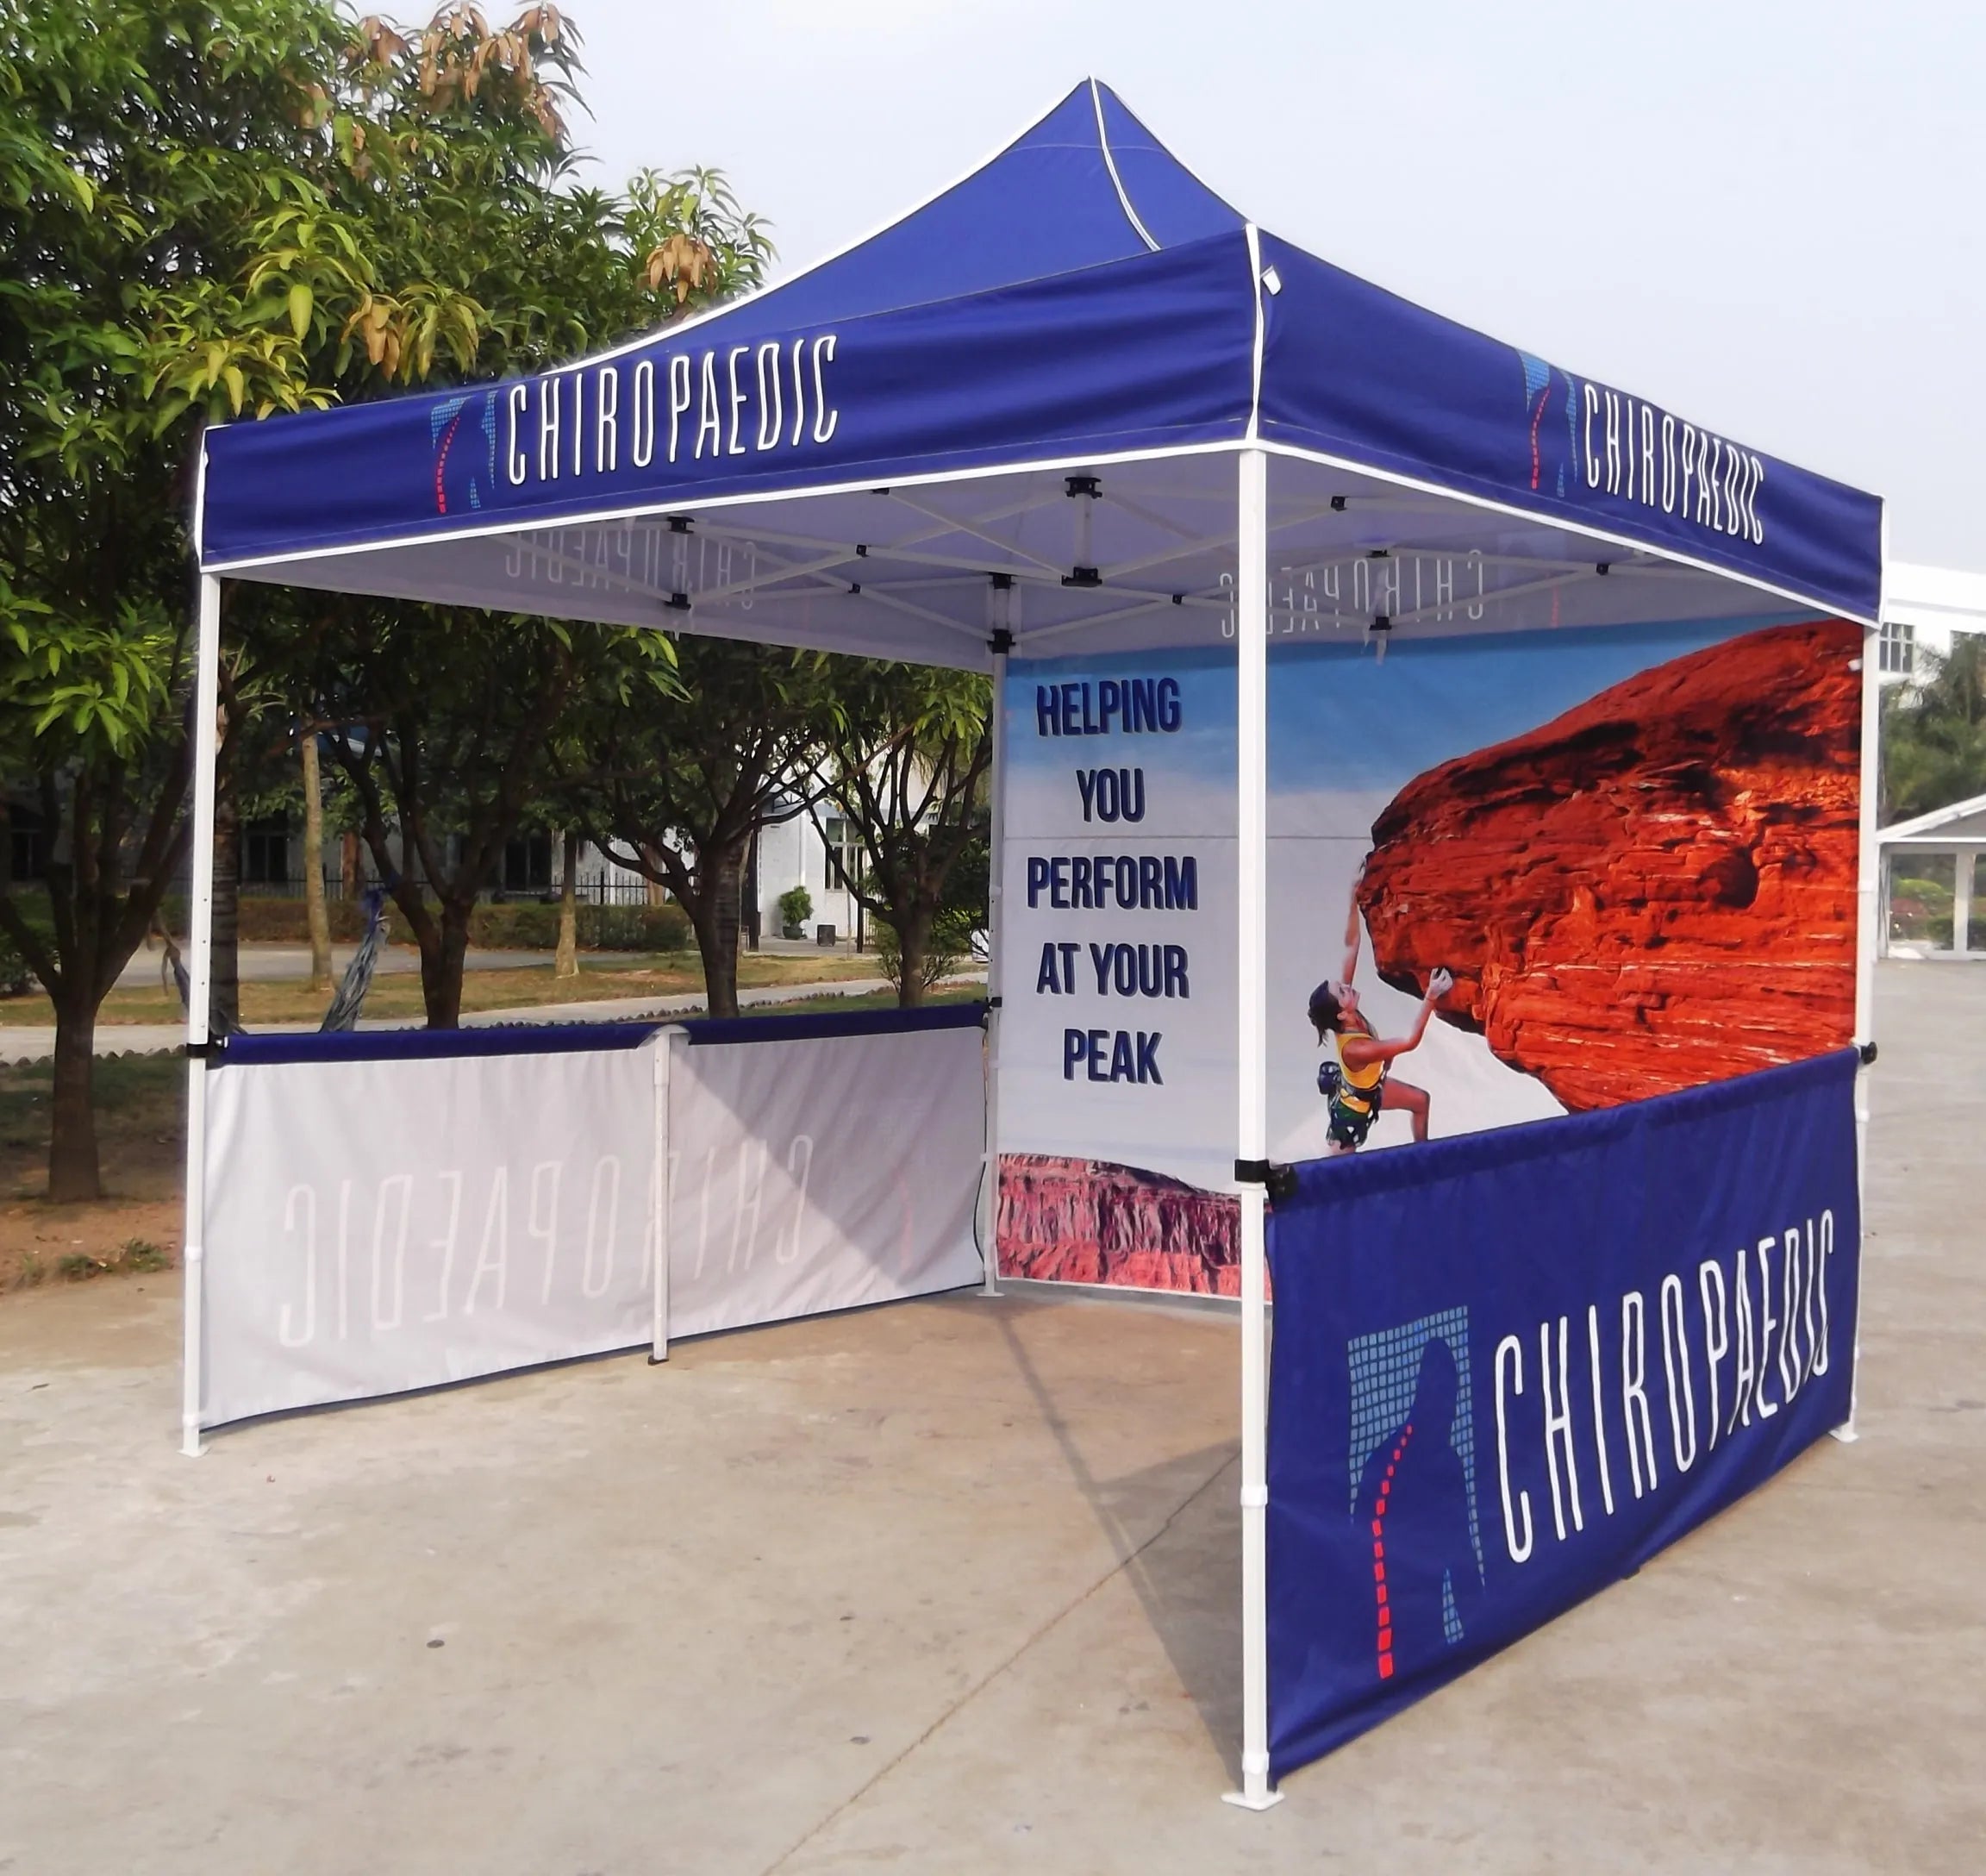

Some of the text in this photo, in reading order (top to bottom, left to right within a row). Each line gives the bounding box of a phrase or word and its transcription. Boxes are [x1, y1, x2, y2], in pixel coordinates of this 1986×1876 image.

[509, 335, 838, 485] CHIROPAEDIC
[1584, 384, 1764, 545] CHIROPAEDIC
[1036, 678, 1182, 736] HELPING
[1076, 768, 1146, 823] YOU
[1027, 856, 1198, 911] PERFORM
[1036, 943, 1190, 999] AT YOUR
[1064, 1029, 1164, 1085] PEAK
[1496, 1209, 1833, 1563] CHIROPAEDIC
